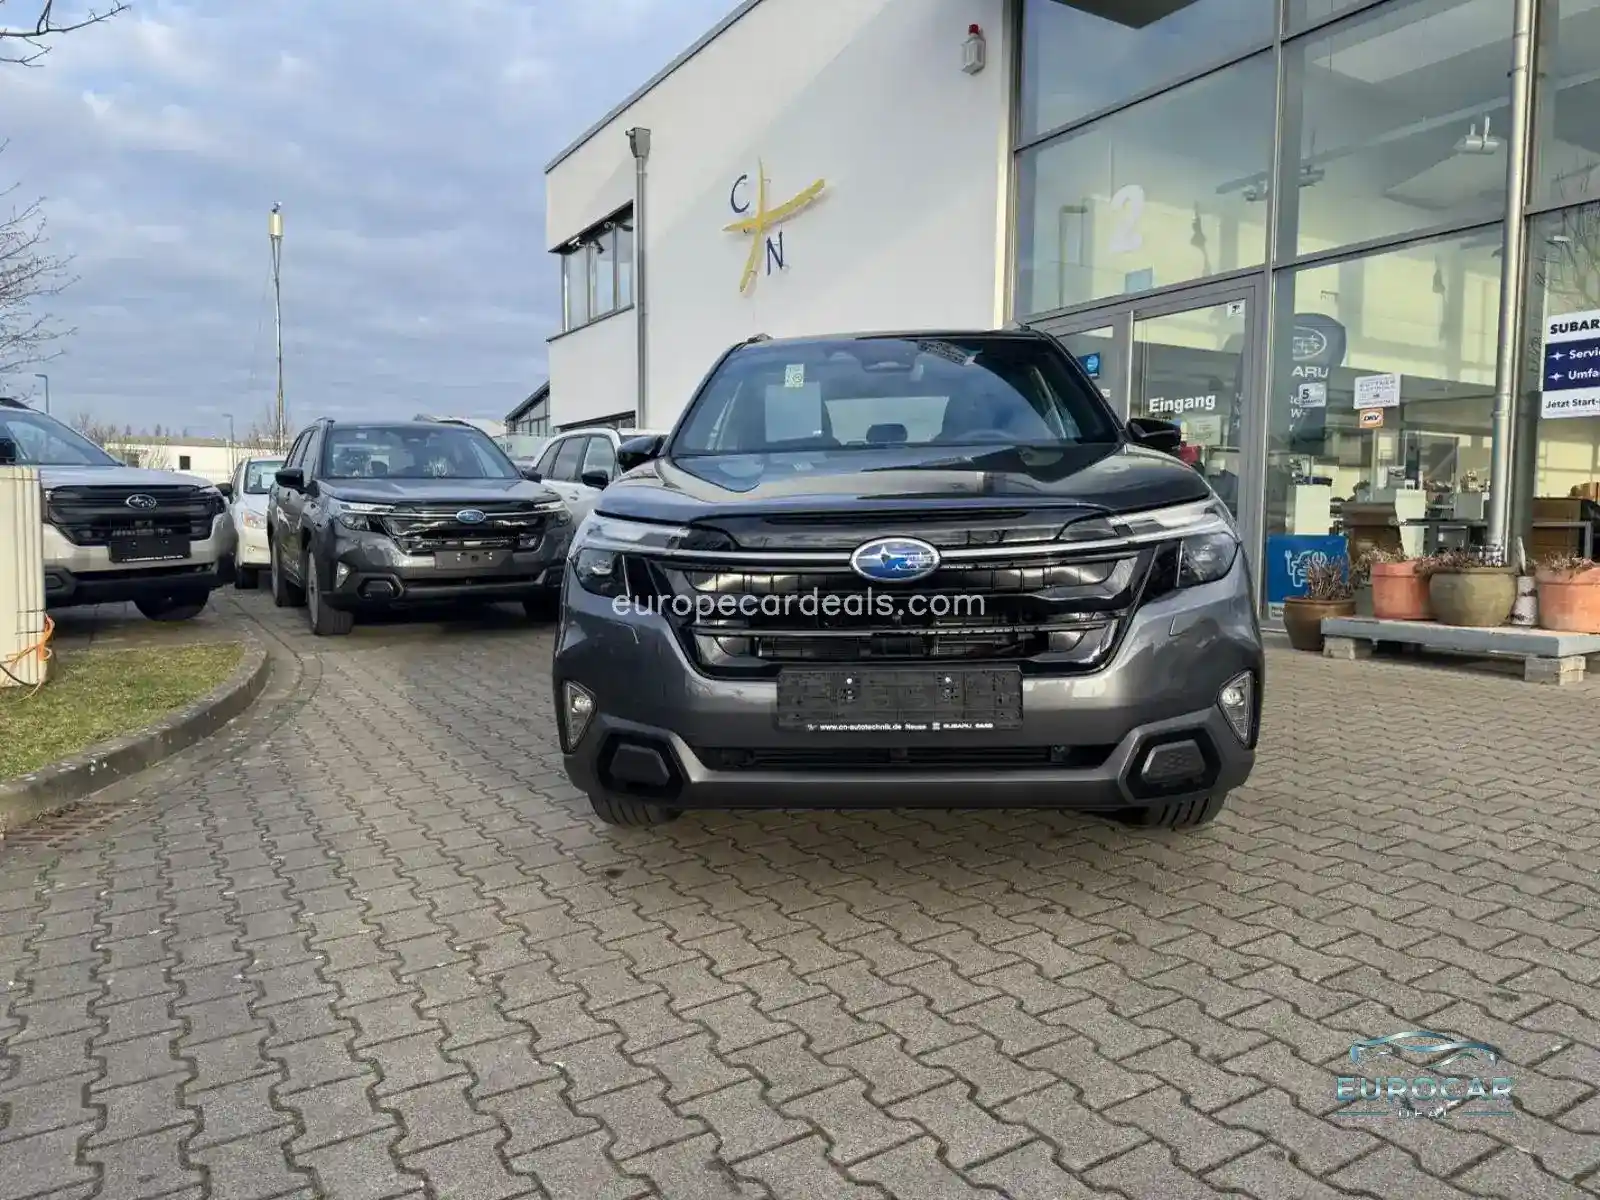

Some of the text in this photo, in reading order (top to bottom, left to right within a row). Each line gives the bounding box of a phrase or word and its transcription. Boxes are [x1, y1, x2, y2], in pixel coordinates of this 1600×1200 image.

[730, 173, 750, 213] C
[1109, 184, 1145, 252] 2
[766, 231, 784, 276] N
[1569, 346, 1600, 360] Servi
[1149, 394, 1216, 413] Eingang
[1546, 400, 1570, 409] Jetzt
